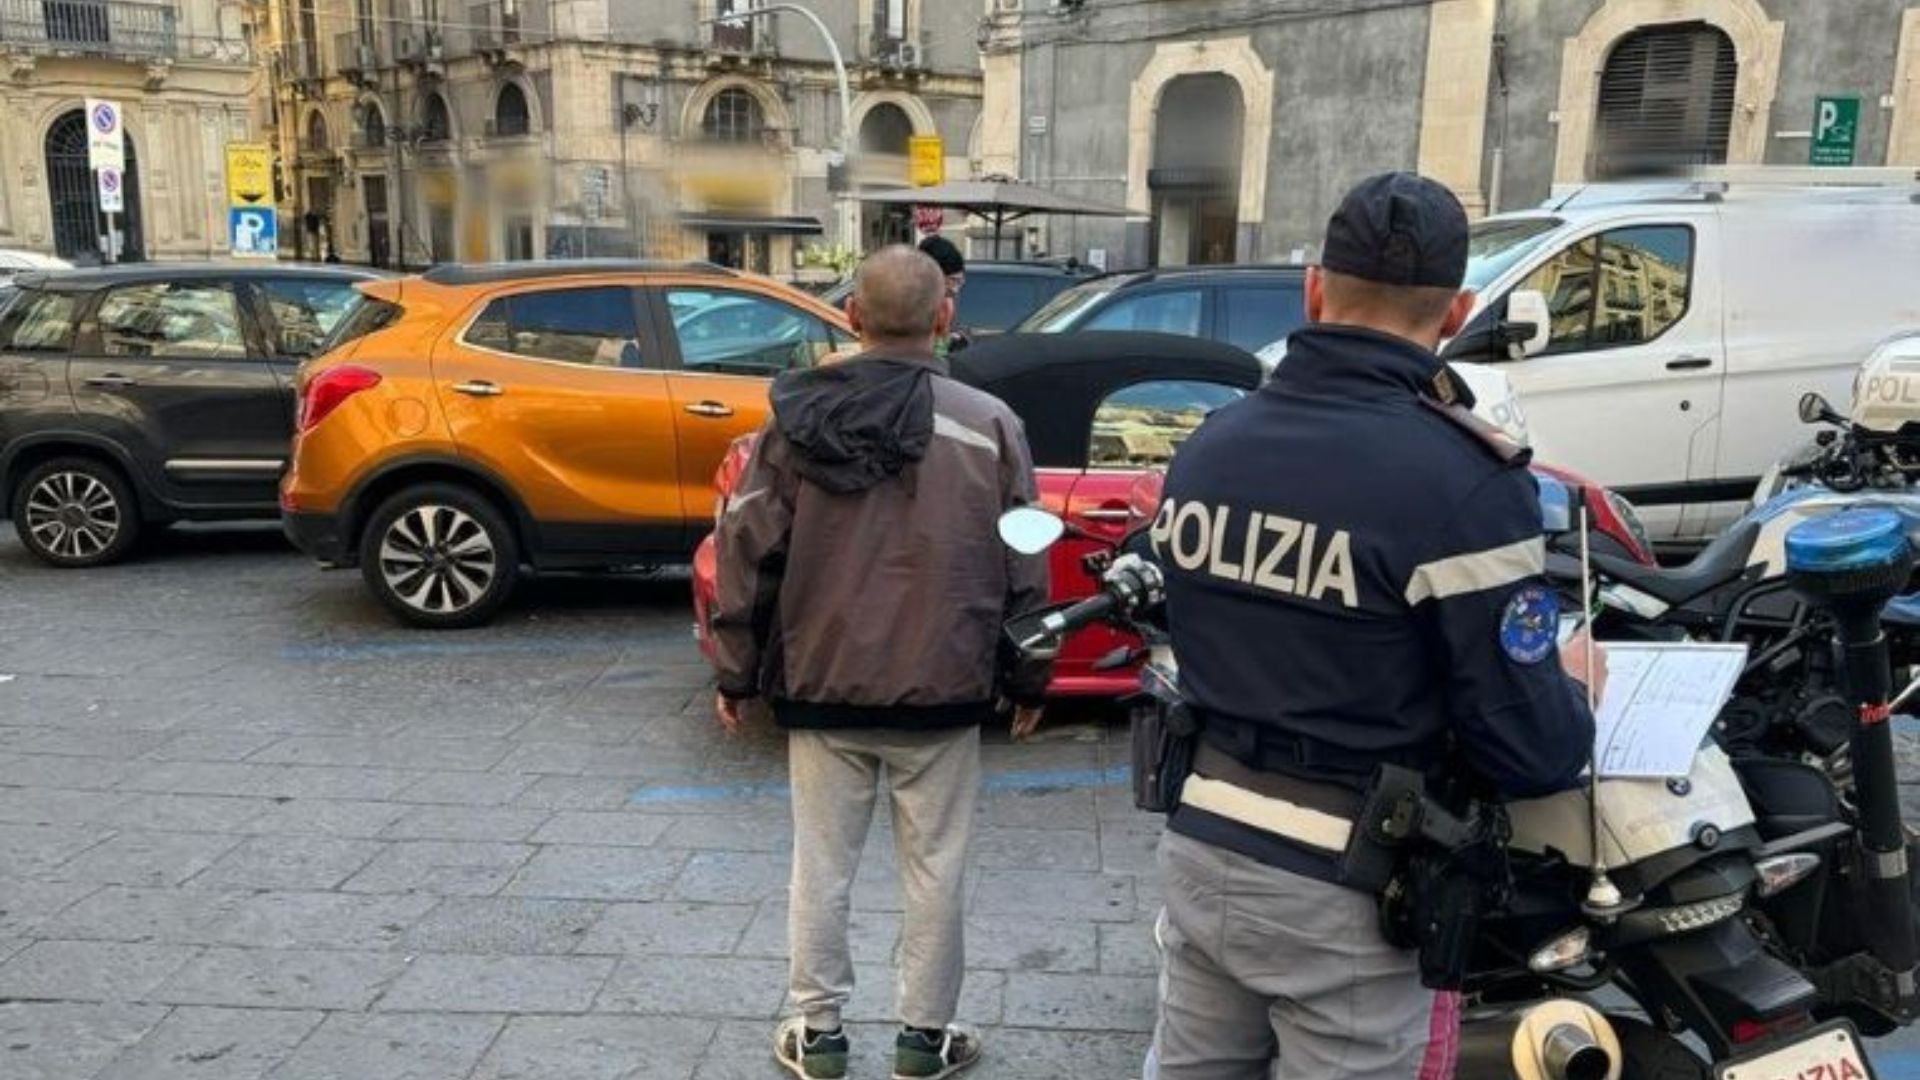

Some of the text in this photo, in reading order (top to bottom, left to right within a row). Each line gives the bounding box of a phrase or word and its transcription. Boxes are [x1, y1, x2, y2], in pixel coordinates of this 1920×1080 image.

[1818, 101, 1838, 141] P
[240, 212, 264, 246] P
[1867, 376, 1918, 403] POL
[1150, 498, 1358, 607] POLIZIA
